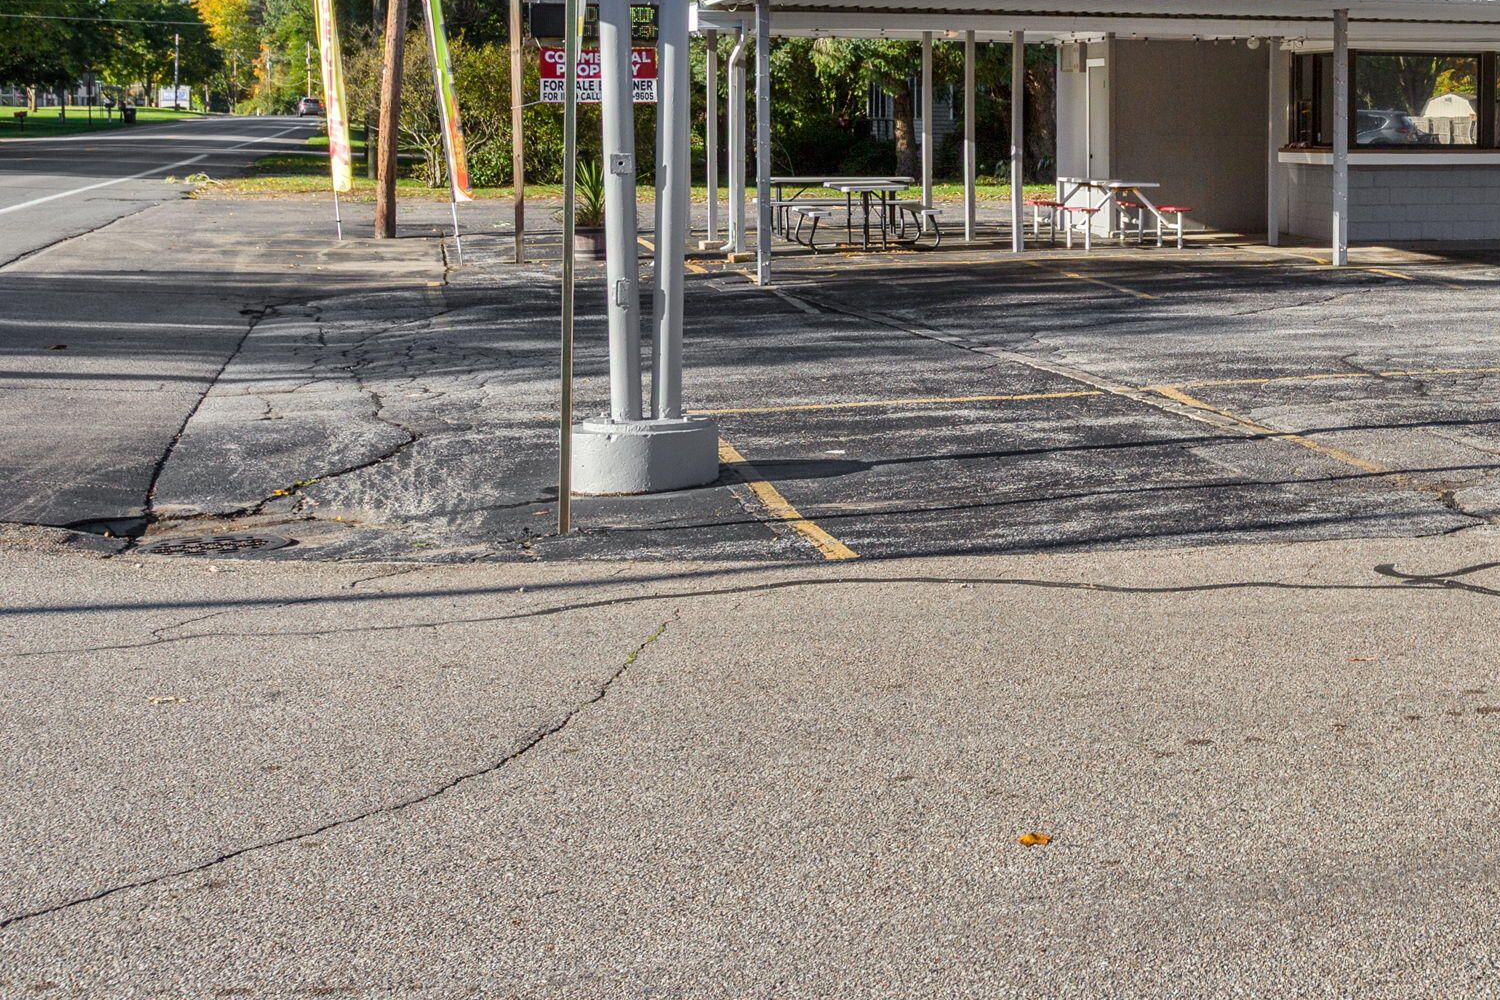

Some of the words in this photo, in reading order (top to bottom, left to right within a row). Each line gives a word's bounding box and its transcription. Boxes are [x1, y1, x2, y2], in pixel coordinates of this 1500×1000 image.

[543, 80, 564, 91] FOR
[571, 80, 595, 91] ALE
[543, 92, 558, 101] FOR
